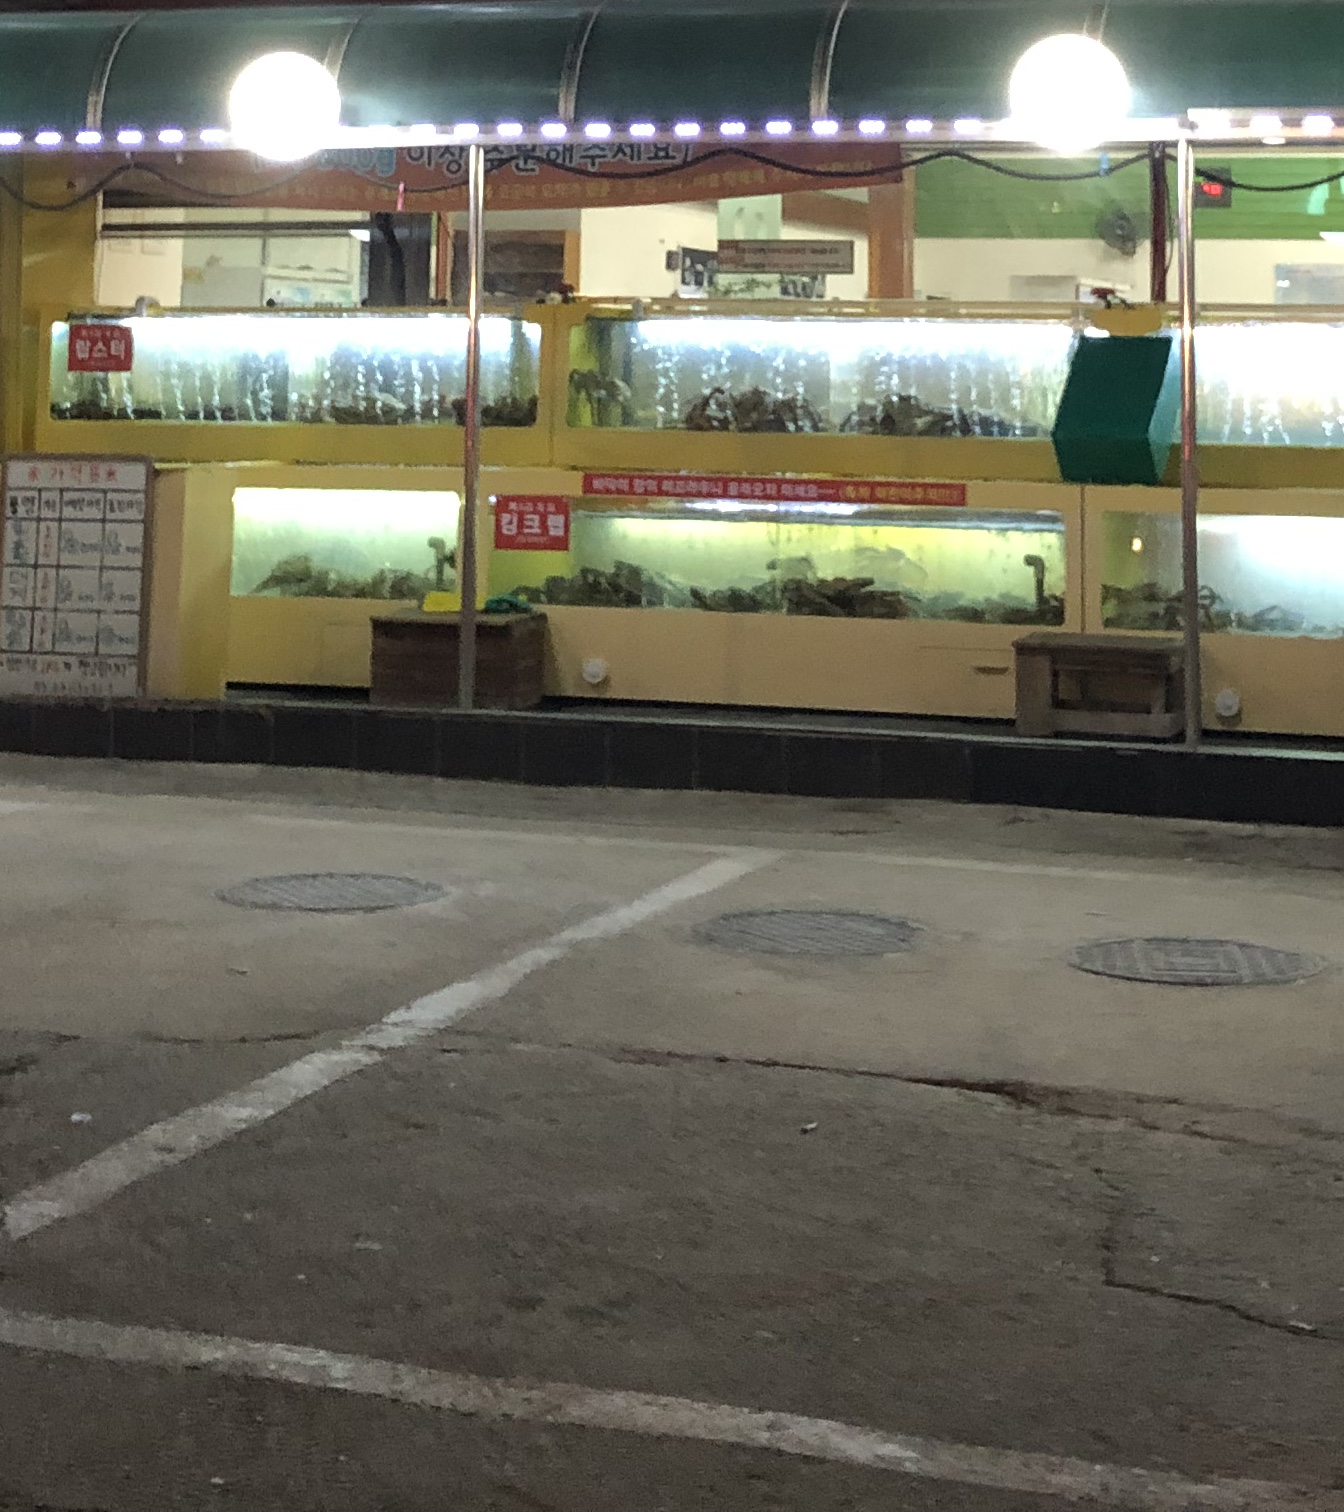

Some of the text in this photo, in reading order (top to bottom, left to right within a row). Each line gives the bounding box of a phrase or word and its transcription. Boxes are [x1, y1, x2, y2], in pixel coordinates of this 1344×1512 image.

[407, 146, 463, 174] 이상
[76, 338, 125, 361] 랍스터
[500, 512, 565, 536] 킹크랩
